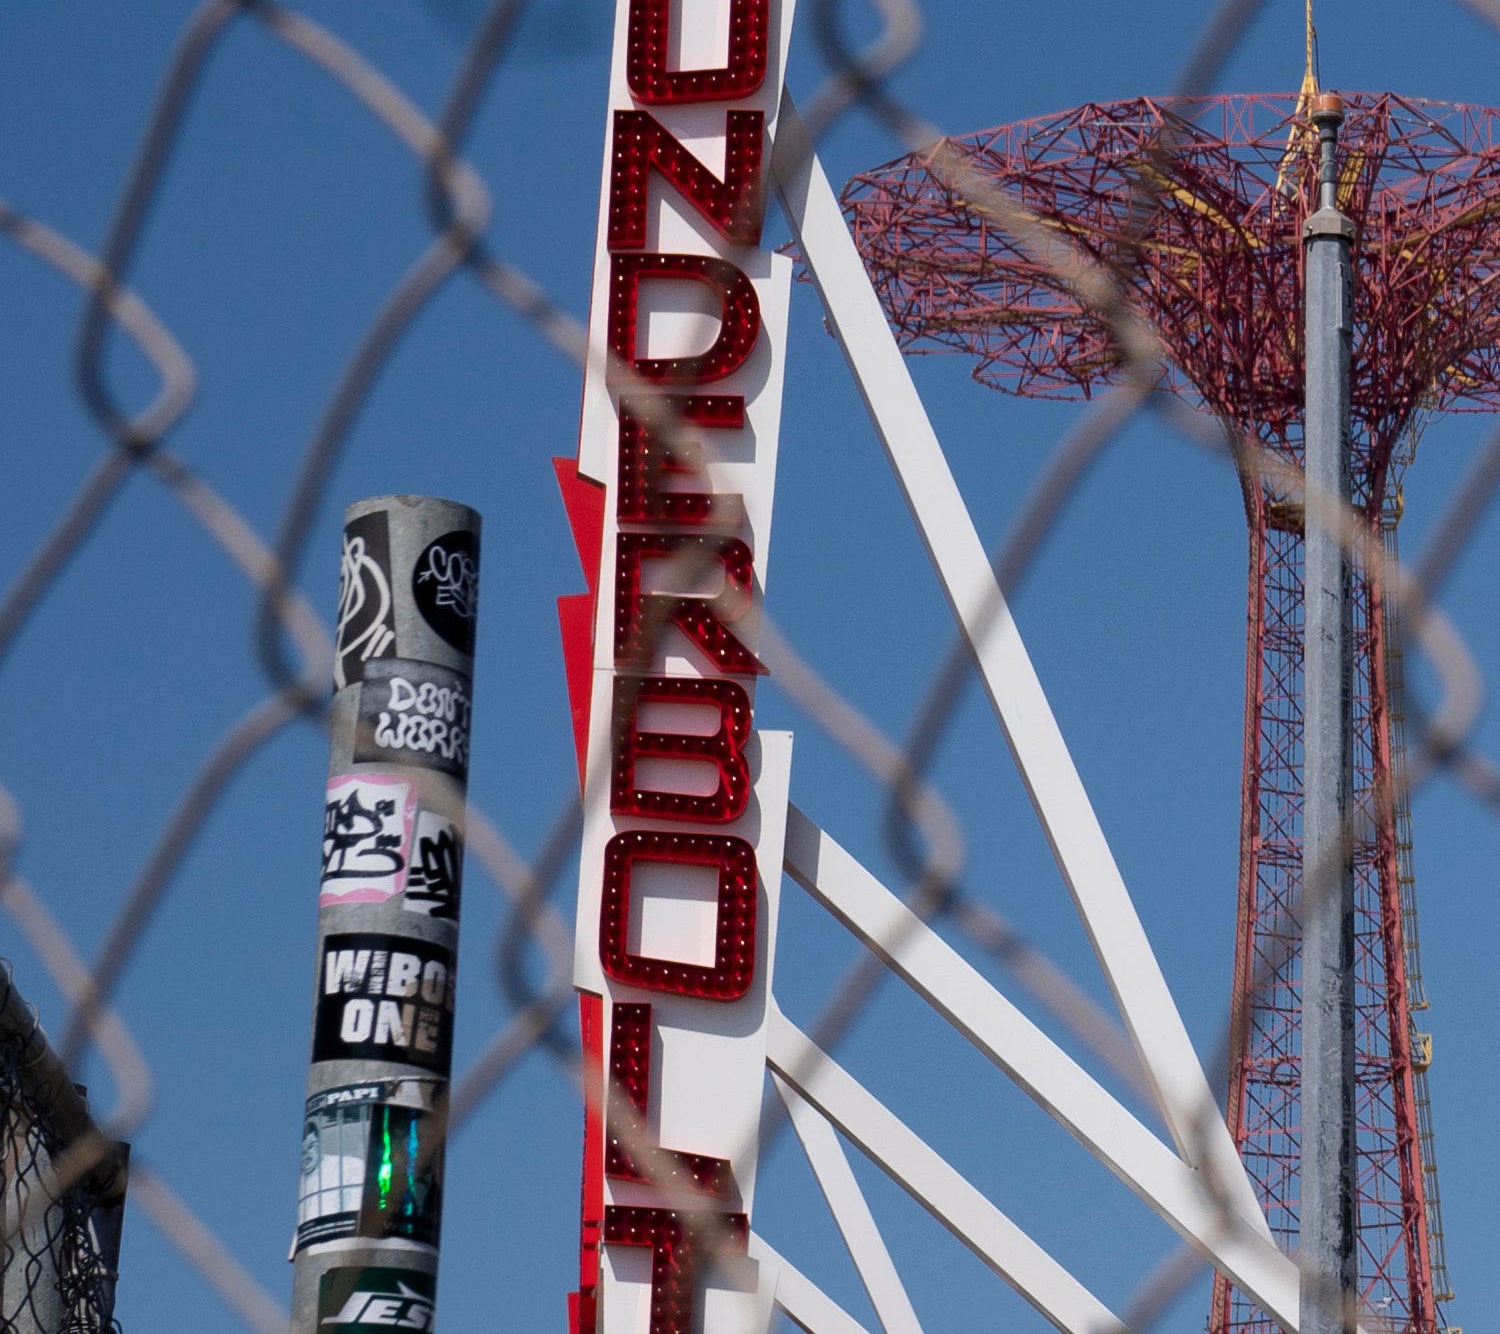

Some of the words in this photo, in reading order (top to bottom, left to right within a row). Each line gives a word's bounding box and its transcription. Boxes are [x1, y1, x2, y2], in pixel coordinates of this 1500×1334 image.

[374, 711, 470, 764] WORR
[340, 998, 440, 1053] ONE
[327, 1086, 380, 1105] PAPI
